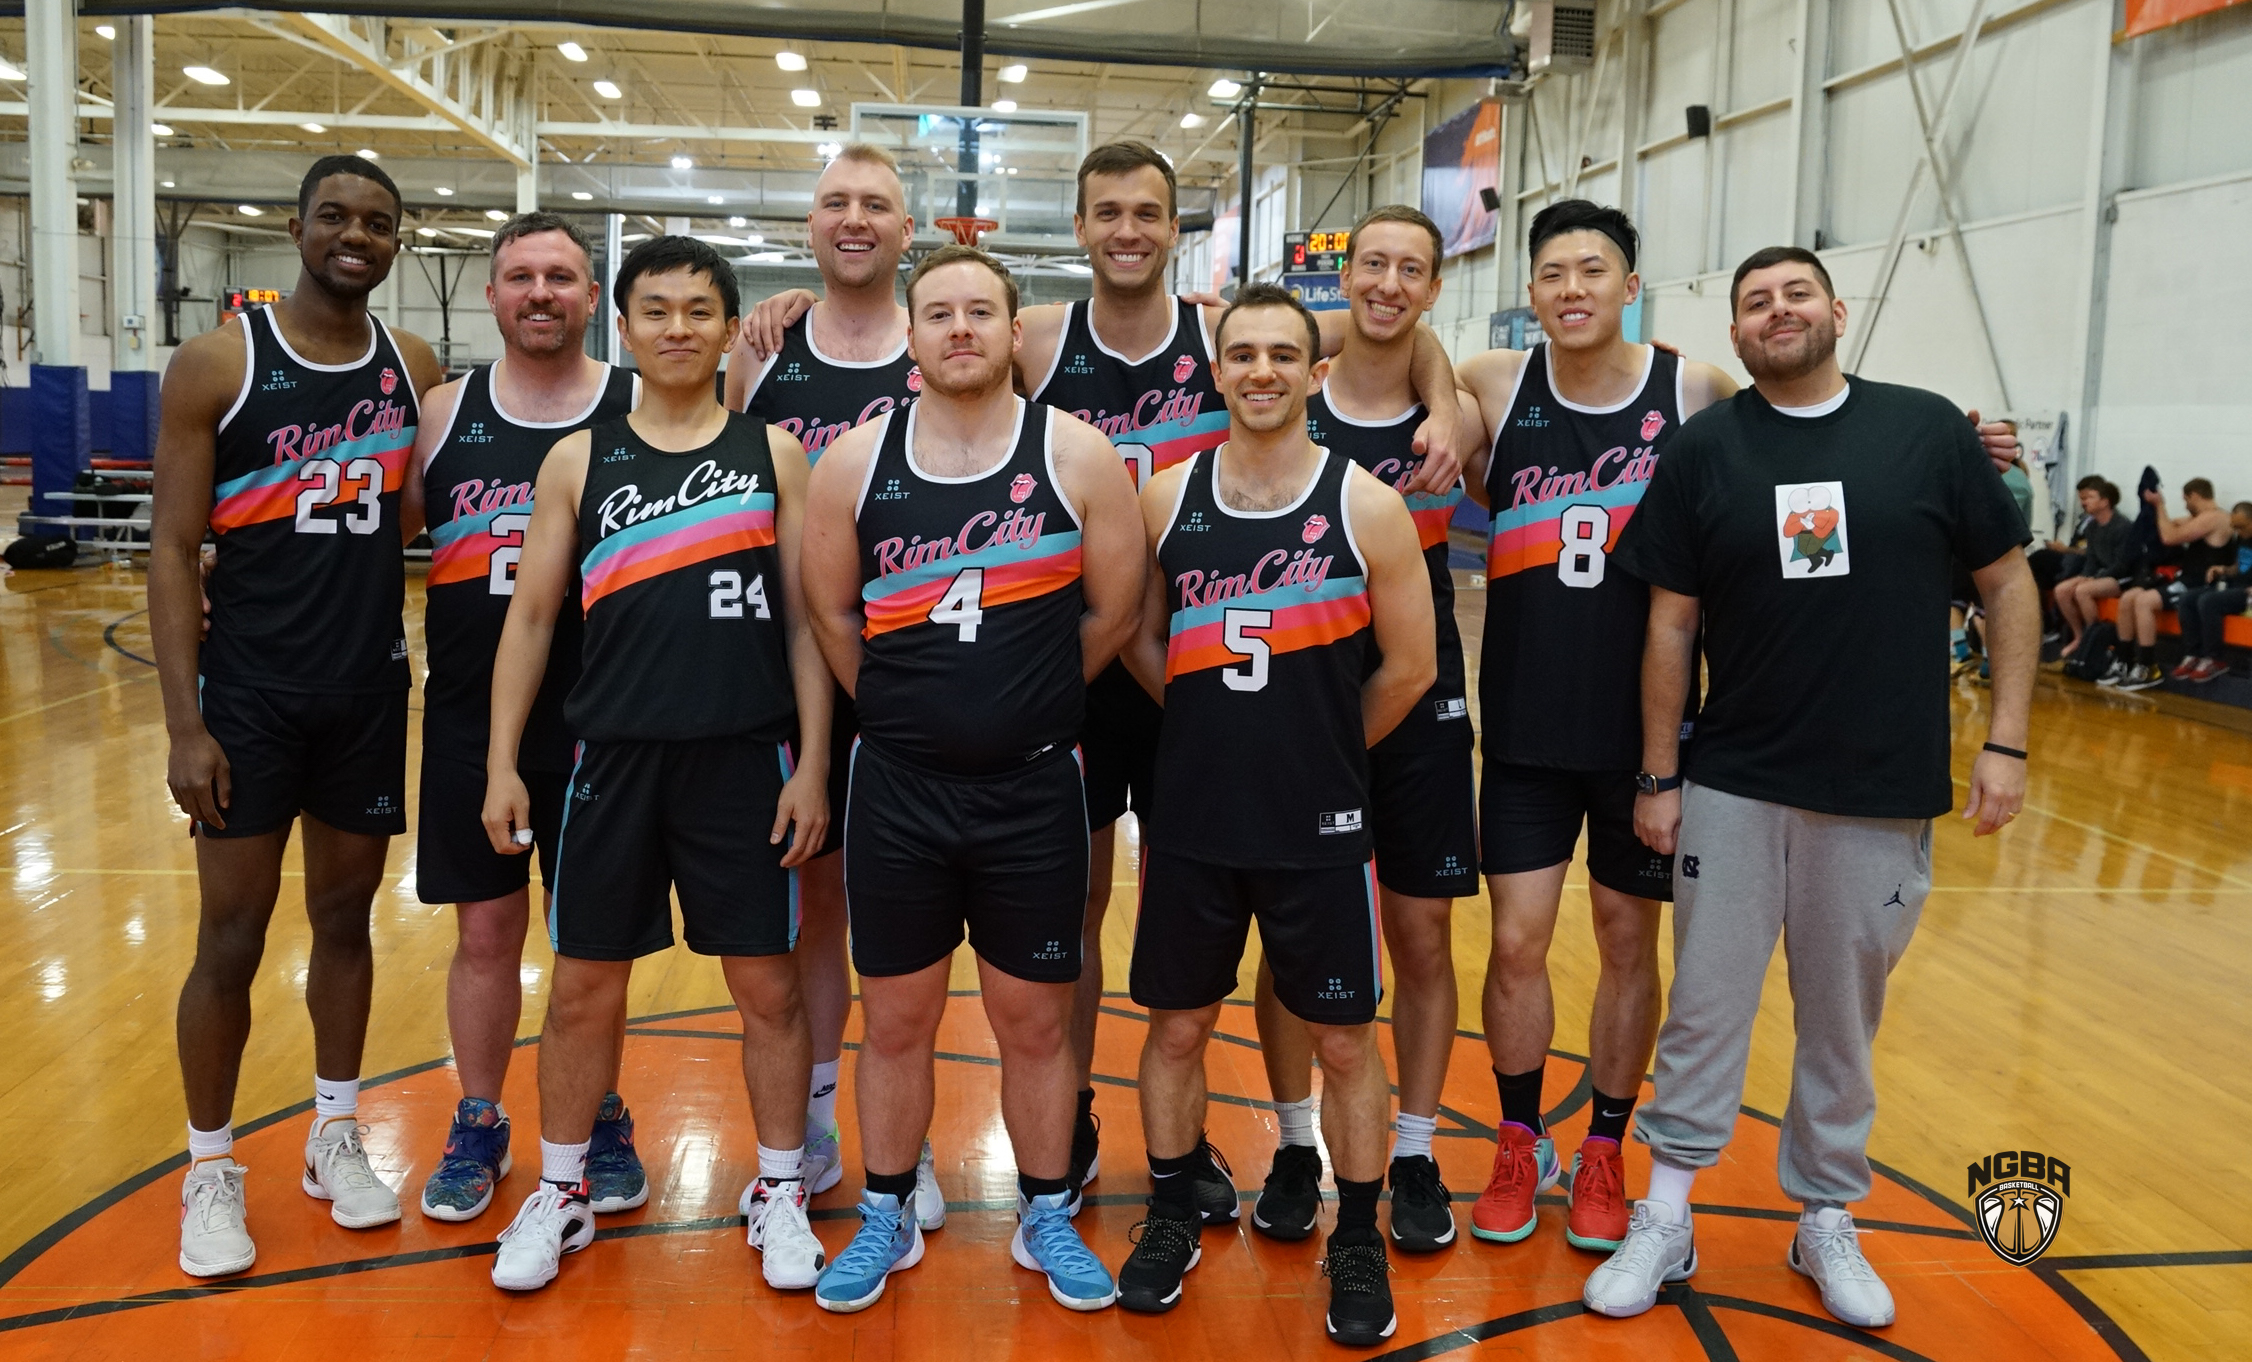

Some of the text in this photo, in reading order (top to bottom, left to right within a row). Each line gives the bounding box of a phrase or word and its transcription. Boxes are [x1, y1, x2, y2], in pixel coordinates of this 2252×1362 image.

[1064, 366, 1095, 374] XEIST
[776, 374, 811, 382] XEIST
[262, 381, 298, 391] XEIST
[1132, 387, 1204, 431] City
[1516, 418, 1550, 428] XEIST
[267, 399, 406, 467] Rim City
[458, 435, 494, 443] XEIST
[603, 454, 637, 464] XEIST
[1511, 465, 1590, 511] Rim
[295, 457, 384, 535] 23
[450, 478, 535, 523] Rim
[597, 459, 759, 538] Rim City
[874, 491, 911, 500] XEIST
[1179, 524, 1211, 532] XEIST
[873, 507, 1046, 580] Rim City
[1558, 503, 1611, 588] 8
[489, 512, 533, 596] 2
[1175, 548, 1334, 613] Rim City
[708, 568, 772, 621] 24
[926, 566, 985, 643] 4
[1222, 607, 1273, 692] 5
[365, 806, 398, 815] XEIST
[1346, 813, 1355, 823] M
[1435, 867, 1468, 877] XEIST
[1638, 869, 1672, 880] XEIST
[1032, 951, 1068, 960] XEIST
[1317, 990, 1355, 999] XEIST
